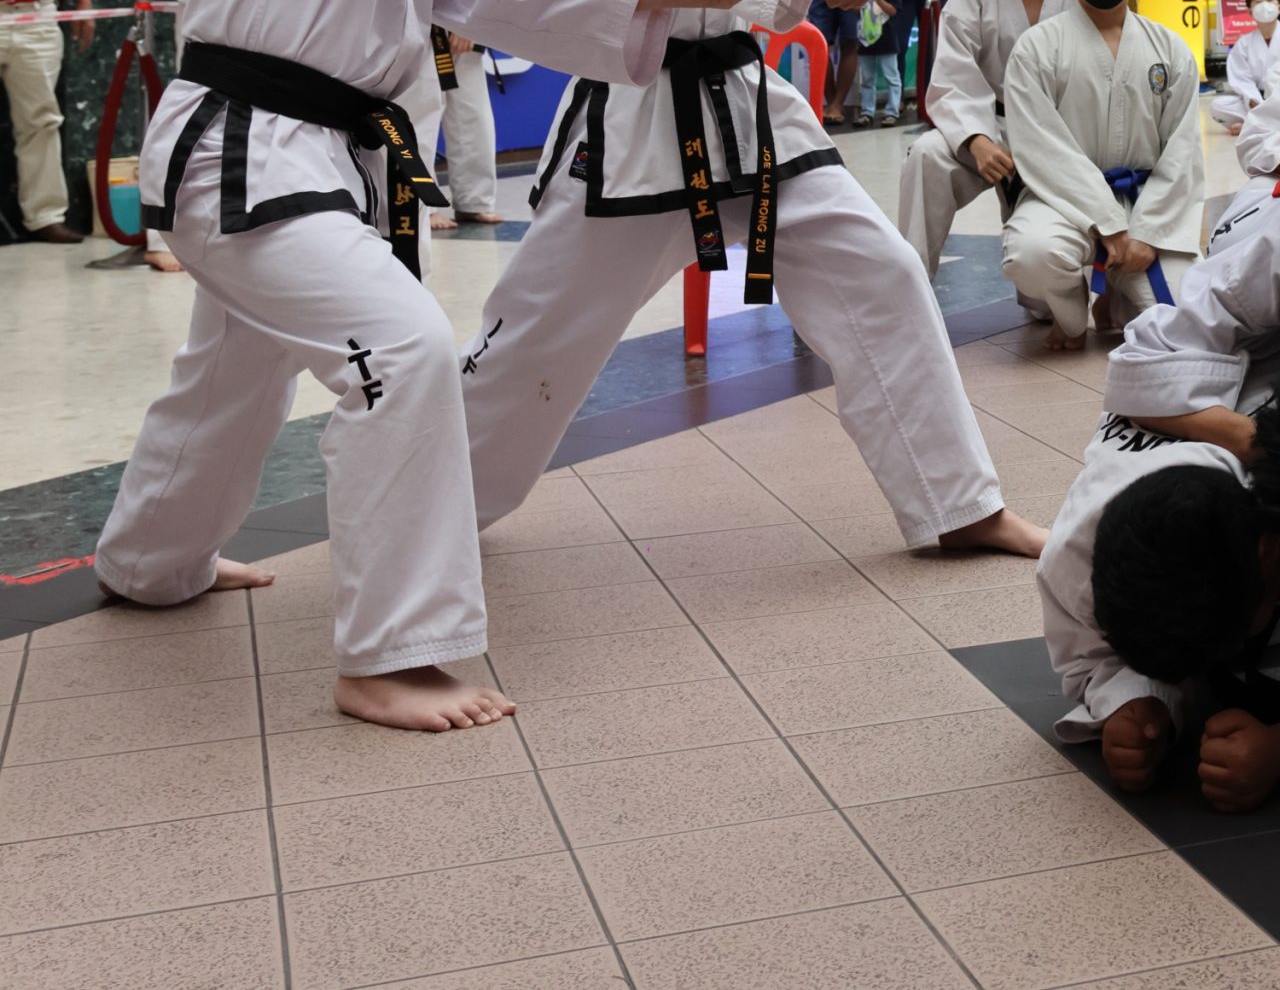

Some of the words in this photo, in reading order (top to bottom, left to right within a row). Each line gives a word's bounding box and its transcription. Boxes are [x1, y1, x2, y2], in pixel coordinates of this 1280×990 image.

[379, 118, 404, 146] RONG
[400, 149, 414, 159] YI
[763, 145, 772, 170] JOE
[761, 173, 771, 194] LAI
[756, 198, 770, 233] RONG
[755, 238, 766, 254] ZU
[347, 337, 383, 411] ITF
